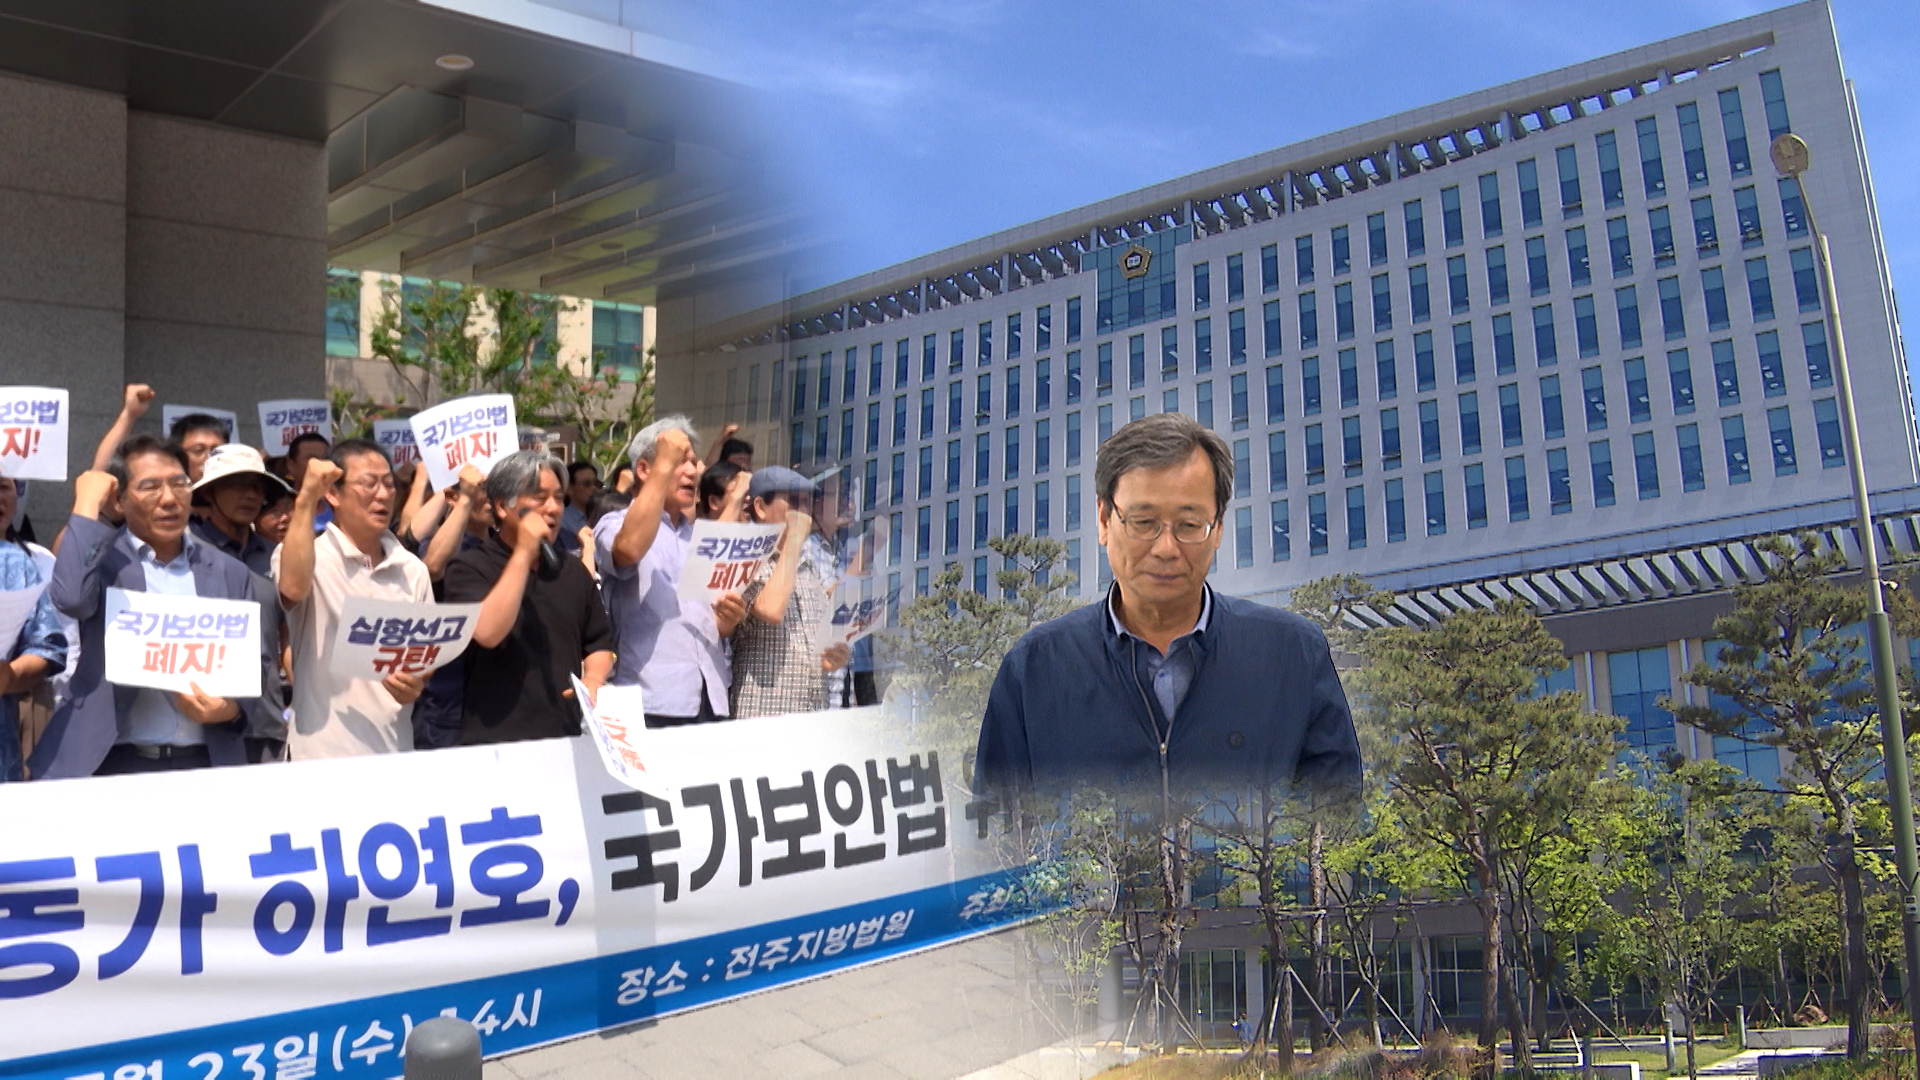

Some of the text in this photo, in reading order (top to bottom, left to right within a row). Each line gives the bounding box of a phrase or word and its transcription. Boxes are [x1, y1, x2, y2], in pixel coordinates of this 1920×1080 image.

[423, 404, 508, 447] 국가보안법
[444, 430, 498, 471] 폐지!
[116, 609, 250, 639] 국가보안법
[142, 642, 226, 675] 폐지!
[249, 806, 580, 956] 하연호,
[601, 750, 946, 902] 국가보안법
[440, 988, 542, 1036] 4시
[617, 959, 688, 1005] 장소
[724, 908, 915, 981] 전주지방법원
